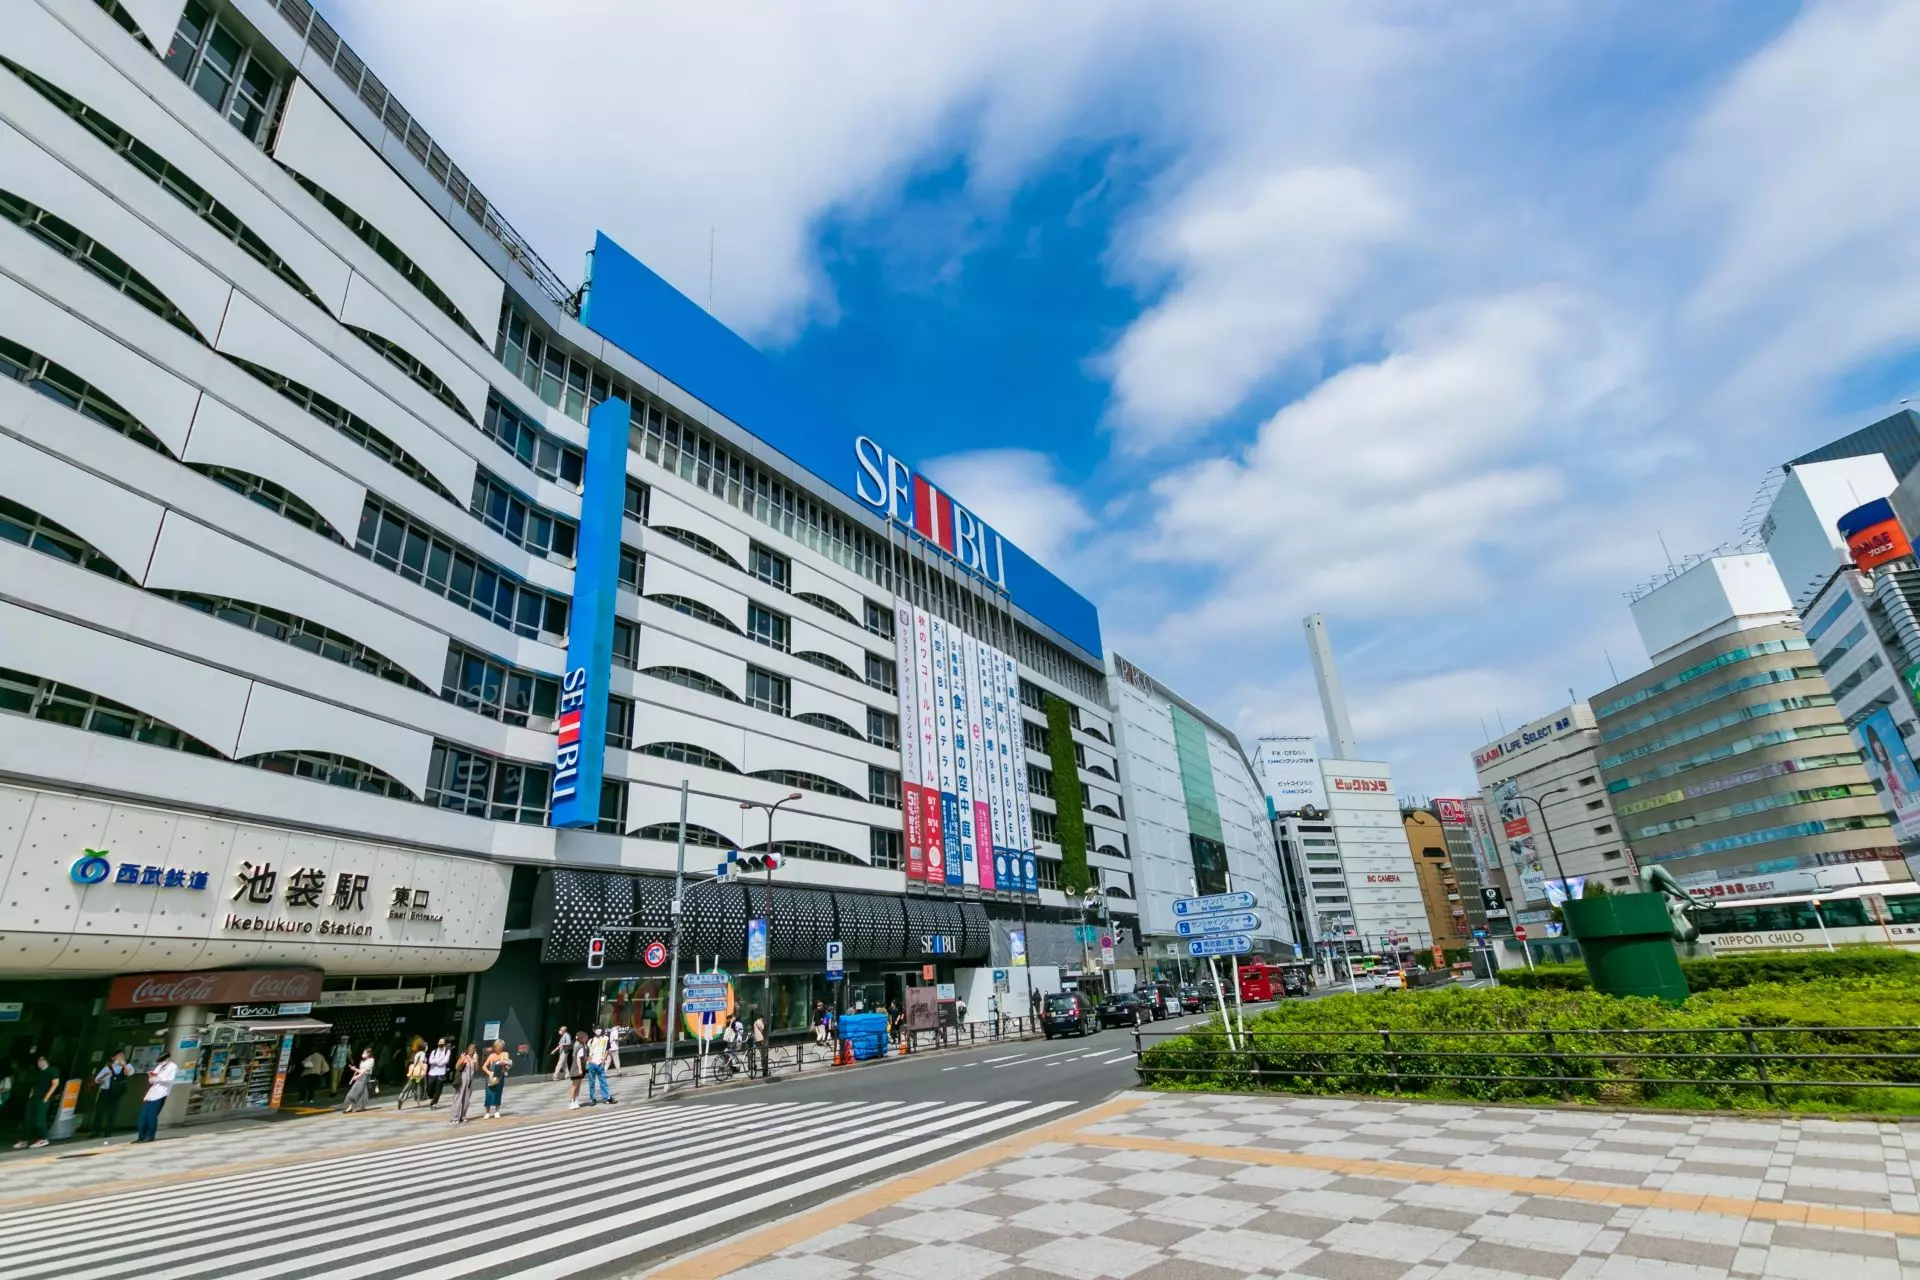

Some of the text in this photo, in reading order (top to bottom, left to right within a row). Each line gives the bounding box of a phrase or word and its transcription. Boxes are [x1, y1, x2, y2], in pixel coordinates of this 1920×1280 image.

[855, 435, 1006, 590] SEIBU
[918, 615, 934, 783] 秋のワコールバザール
[933, 621, 950, 788] 天空のBBQテラス
[553, 667, 586, 803] SEIBU
[1504, 739, 1522, 753] LIFE
[1522, 724, 1552, 745] SELECT
[953, 693, 973, 862] 食と緑の空中庭園
[1334, 778, 1388, 792] ビックカメラ
[992, 795, 1001, 843] OPEN
[1006, 799, 1015, 845] OPEN
[1019, 803, 1029, 848] OPEN
[114, 862, 210, 890] 西武鉄道
[231, 860, 370, 912] 池袋駅
[1377, 874, 1400, 883] CAMERA
[1746, 881, 1775, 892] SELECT
[391, 886, 430, 909] 東口
[224, 914, 373, 937] Ikebukuro Station
[388, 909, 444, 922] East Entrance
[1191, 917, 1240, 928] サンシャインシティ
[1718, 932, 1805, 946] NIPPON CHUO
[1891, 926, 1920, 935] 日本
[829, 944, 840, 959] P
[920, 935, 957, 953] SEIBU
[250, 974, 312, 998] Coca-Cola
[993, 970, 1005, 983] P
[132, 975, 220, 1003] Coca-Cola
